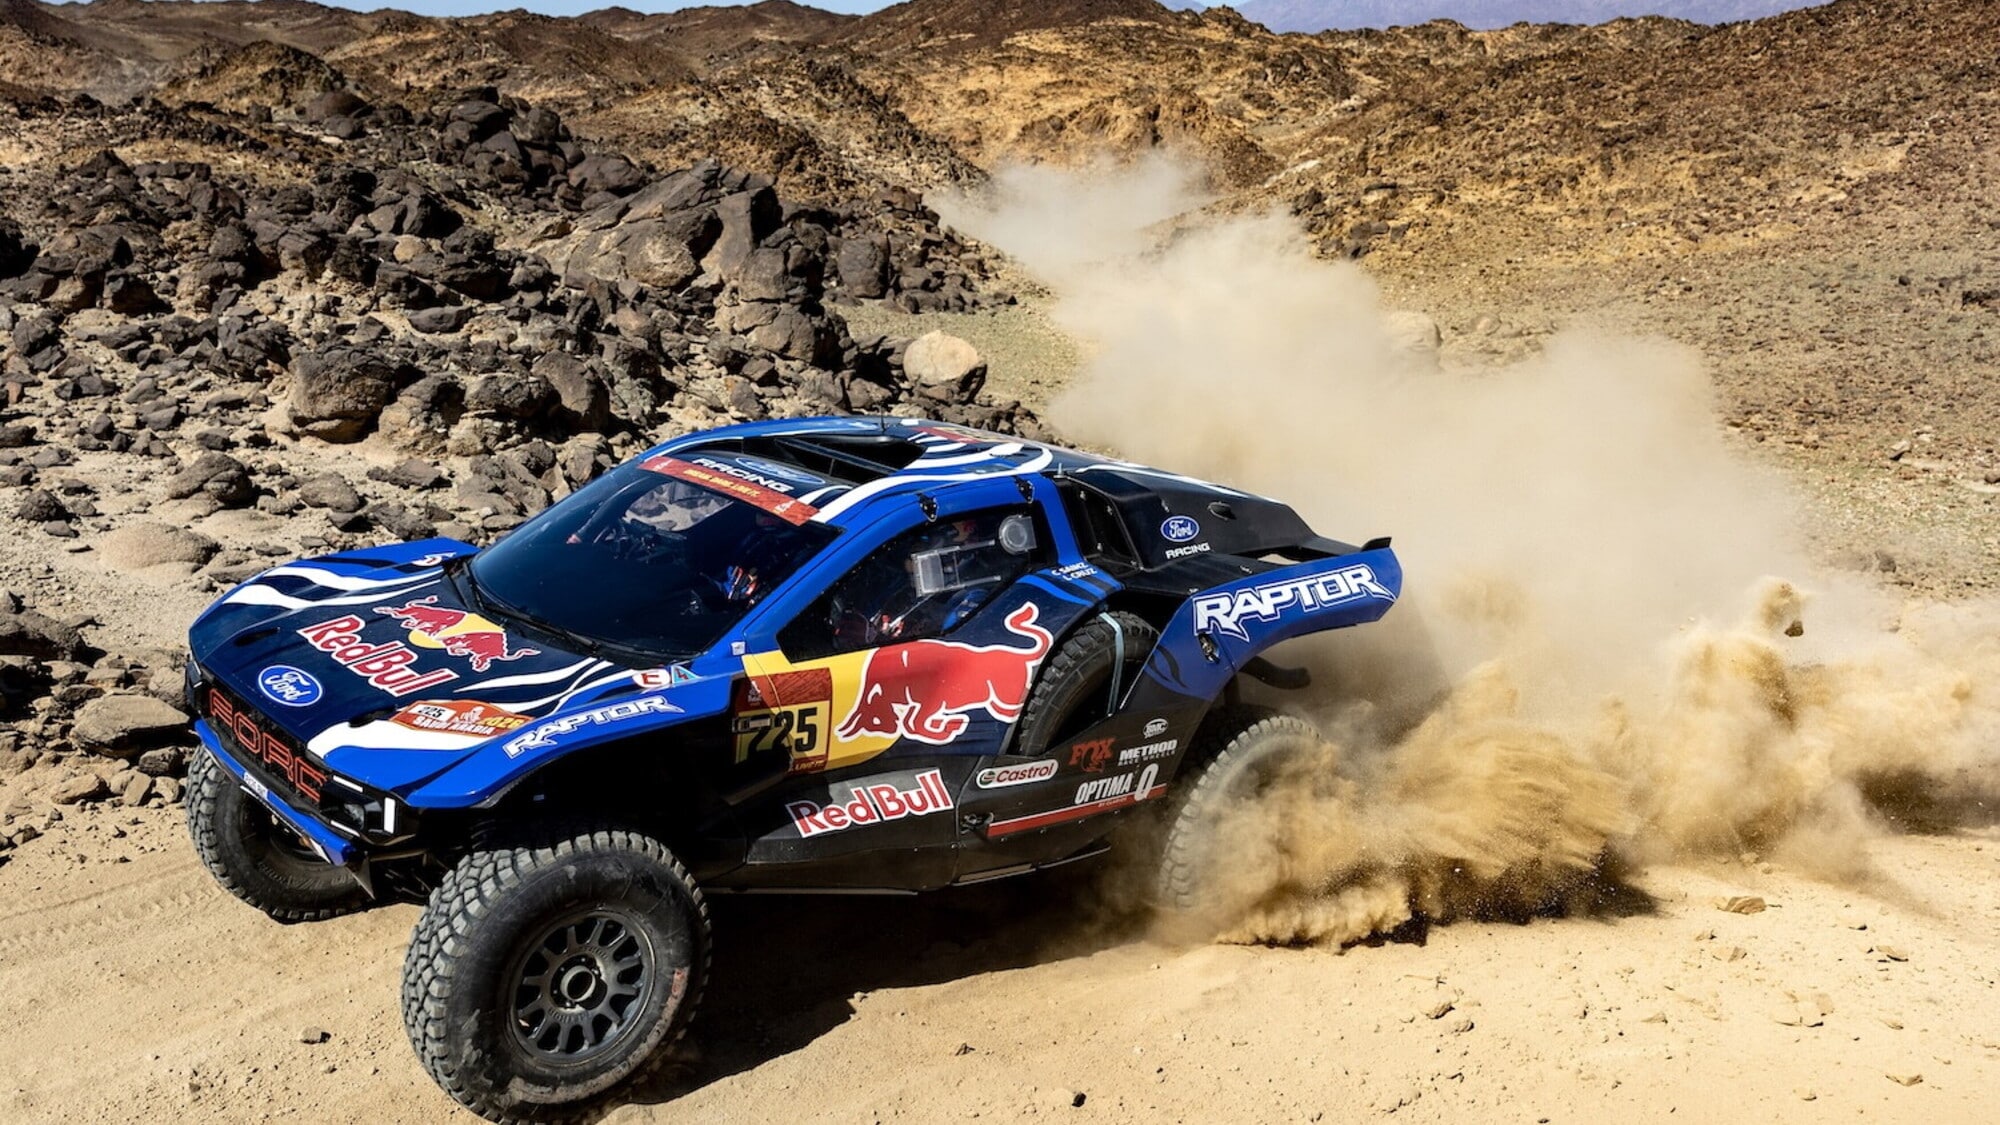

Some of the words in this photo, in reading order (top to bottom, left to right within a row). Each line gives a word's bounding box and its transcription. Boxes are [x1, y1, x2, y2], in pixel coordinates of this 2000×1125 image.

[692, 458, 794, 492] RACING
[1168, 520, 1193, 538] Ford
[1165, 542, 1210, 559] RACING
[1059, 562, 1089, 574] SAINZ
[1071, 568, 1097, 579] CRUZ
[1193, 563, 1397, 642] RAPTOR
[298, 615, 404, 665] Red
[347, 648, 460, 697] Bull
[264, 671, 312, 701] Ford
[412, 715, 451, 730] SAUDI
[447, 721, 496, 736] ARABIA
[418, 706, 447, 719] 225
[478, 716, 525, 729] 2026
[503, 695, 685, 759] RAPTOR
[1068, 737, 1116, 772] FOX
[1119, 739, 1178, 761] METHOD
[995, 763, 1055, 784] Castrol
[1074, 773, 1134, 805] OPTIMA
[785, 788, 882, 838] Red
[867, 769, 954, 821] Bull
